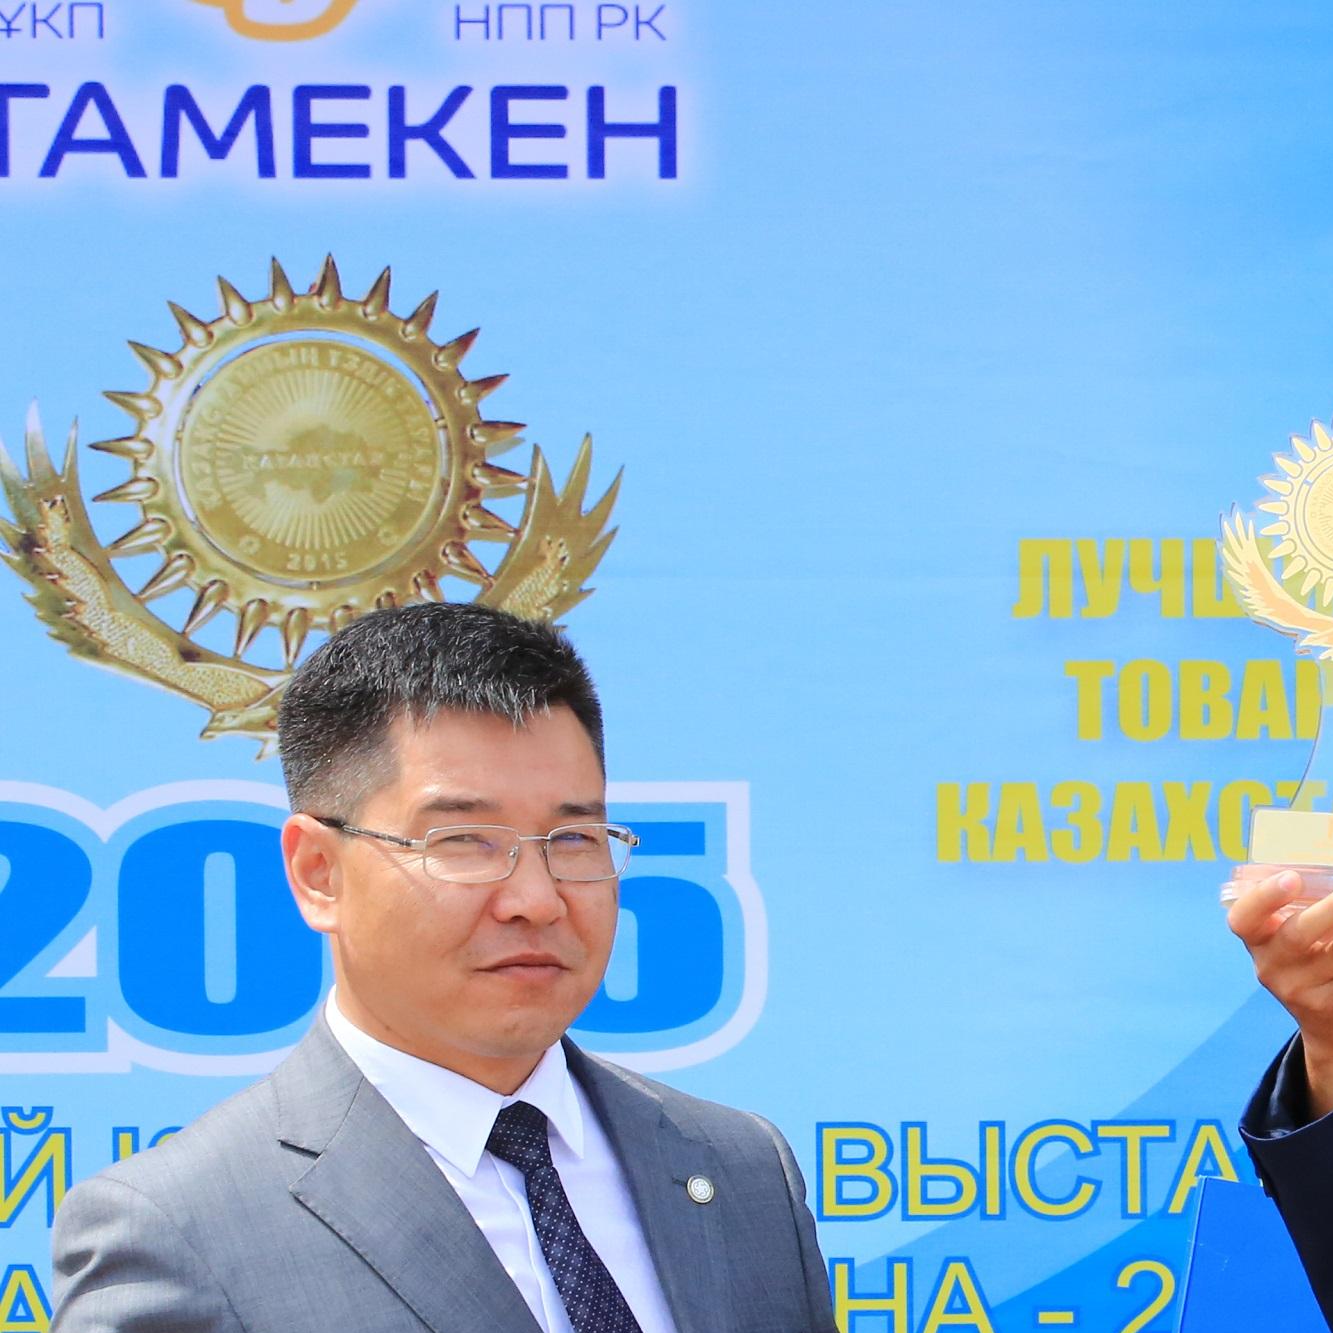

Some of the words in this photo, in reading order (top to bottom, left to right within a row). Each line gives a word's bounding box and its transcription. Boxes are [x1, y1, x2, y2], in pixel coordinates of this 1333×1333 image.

[455, 3, 574, 41] НПП
[598, 3, 667, 41] РК
[0, 800, 745, 1054] 205
